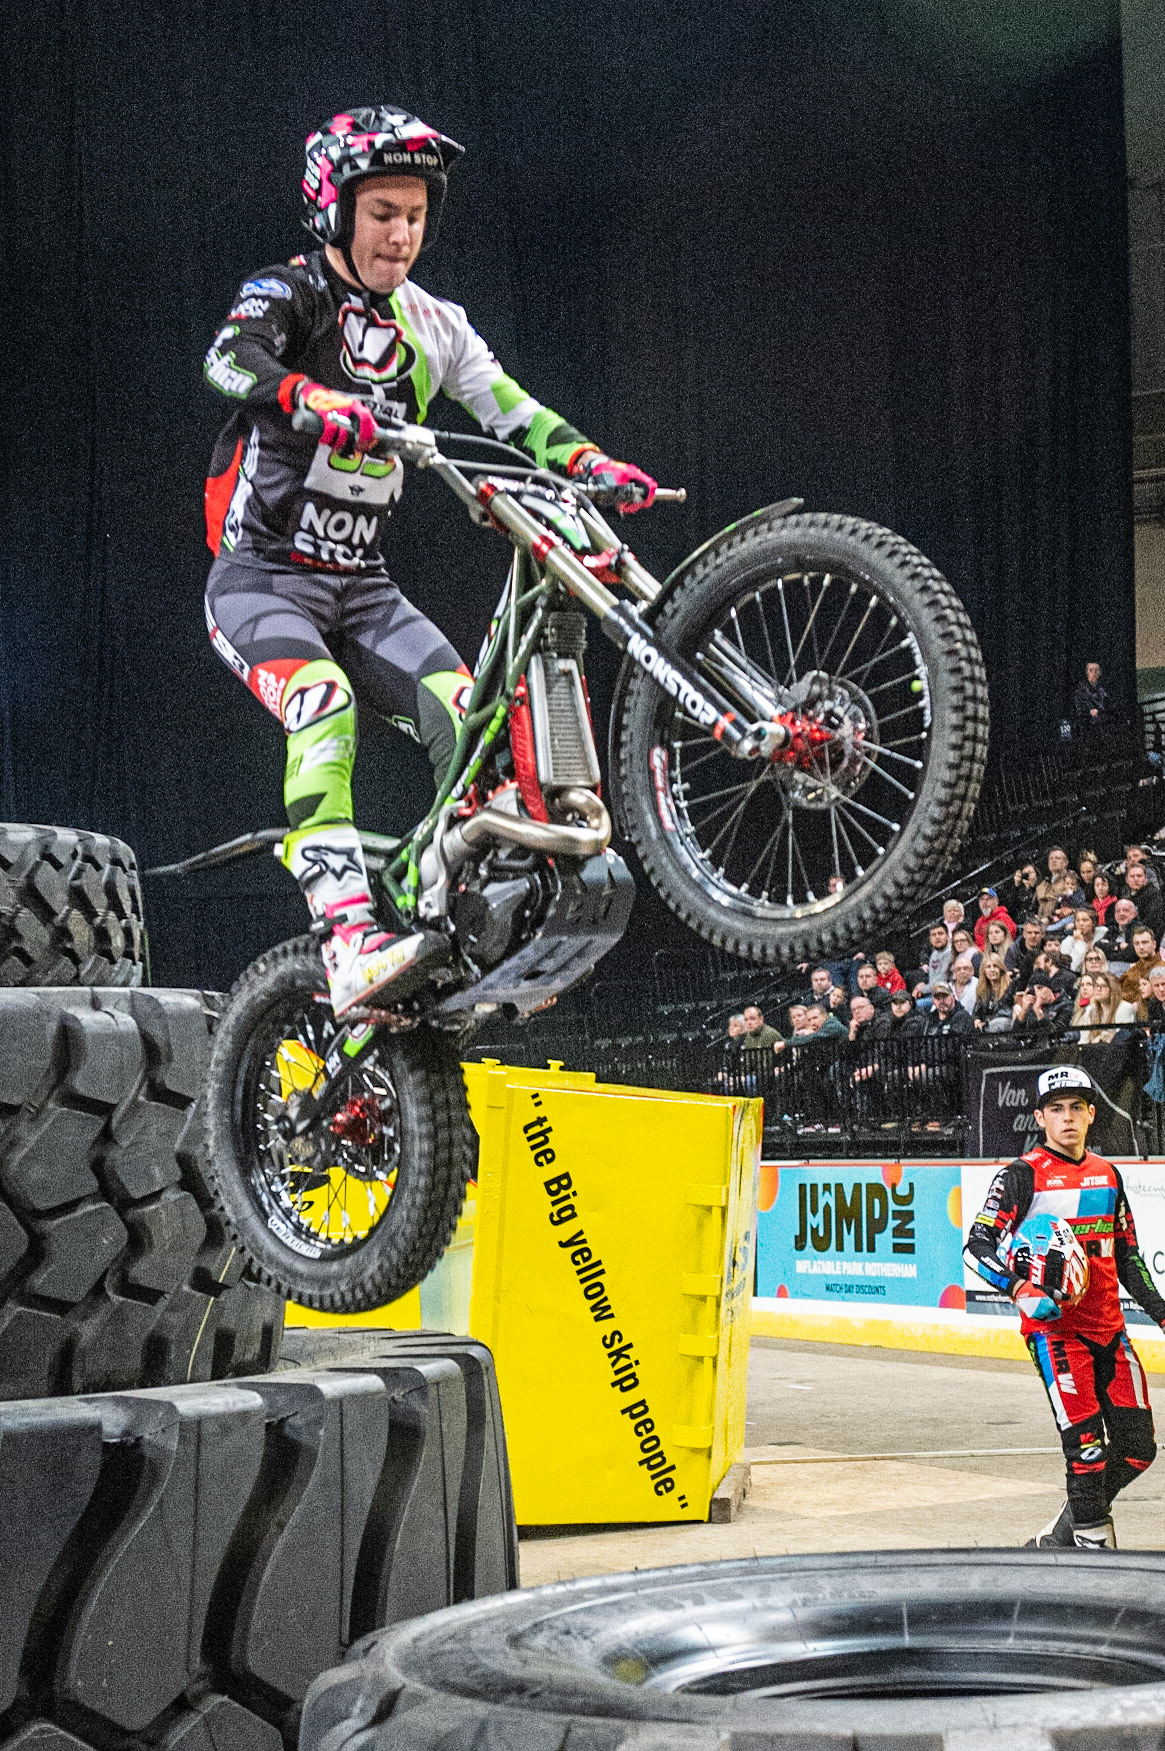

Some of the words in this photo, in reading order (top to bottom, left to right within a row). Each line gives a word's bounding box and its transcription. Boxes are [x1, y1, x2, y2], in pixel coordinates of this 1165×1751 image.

[383, 152, 411, 165] NON
[413, 153, 439, 166] STOP
[300, 501, 379, 546] NON
[627, 632, 718, 725] NONSTOP
[997, 1081, 1029, 1108] Van
[543, 1171, 578, 1227] Big
[794, 1183, 889, 1253] JUMP
[891, 1182, 916, 1255] INC
[796, 1259, 841, 1275] INFLATABLE
[842, 1261, 864, 1276] PARK
[865, 1262, 917, 1279] ROTHERHAM
[1080, 1238, 1115, 1258] RW
[557, 1229, 616, 1323] yellow
[601, 1329, 640, 1393] skip
[1051, 1340, 1078, 1395] MRW
